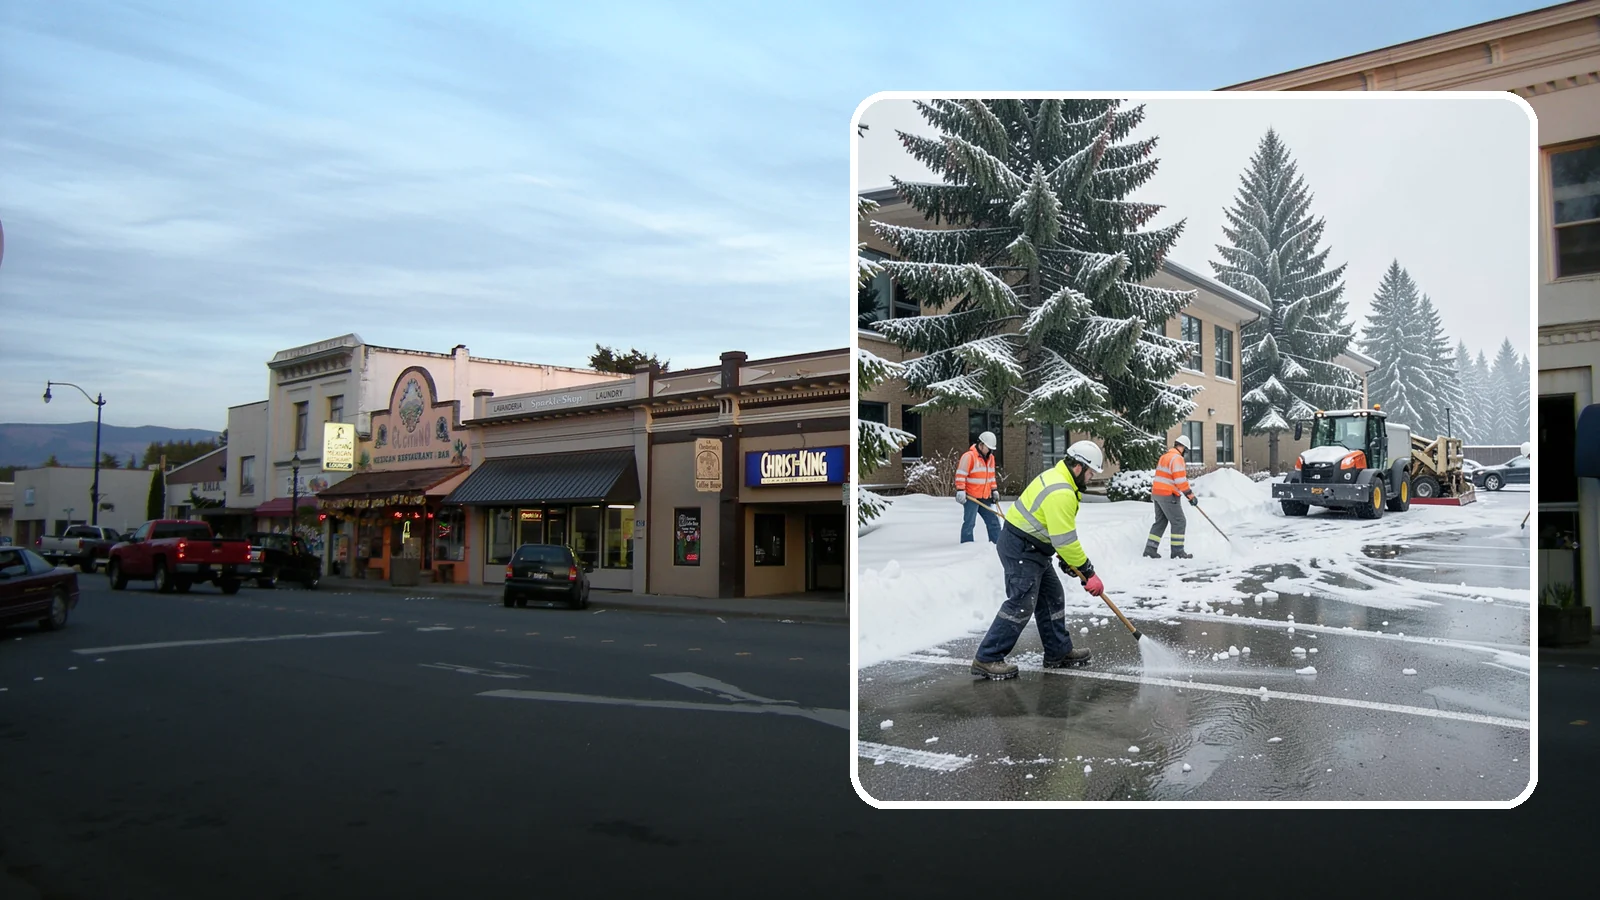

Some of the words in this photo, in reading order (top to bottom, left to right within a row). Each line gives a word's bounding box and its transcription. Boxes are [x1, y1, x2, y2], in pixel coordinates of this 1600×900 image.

[562, 394, 583, 405] Shop
[595, 389, 623, 400] LAUNDRY
[493, 402, 523, 413] LAVANDERIA
[397, 452, 433, 462] RESTAURANT
[437, 450, 450, 459] BAR
[761, 451, 797, 478] CHRIST
[799, 450, 827, 476] KING
